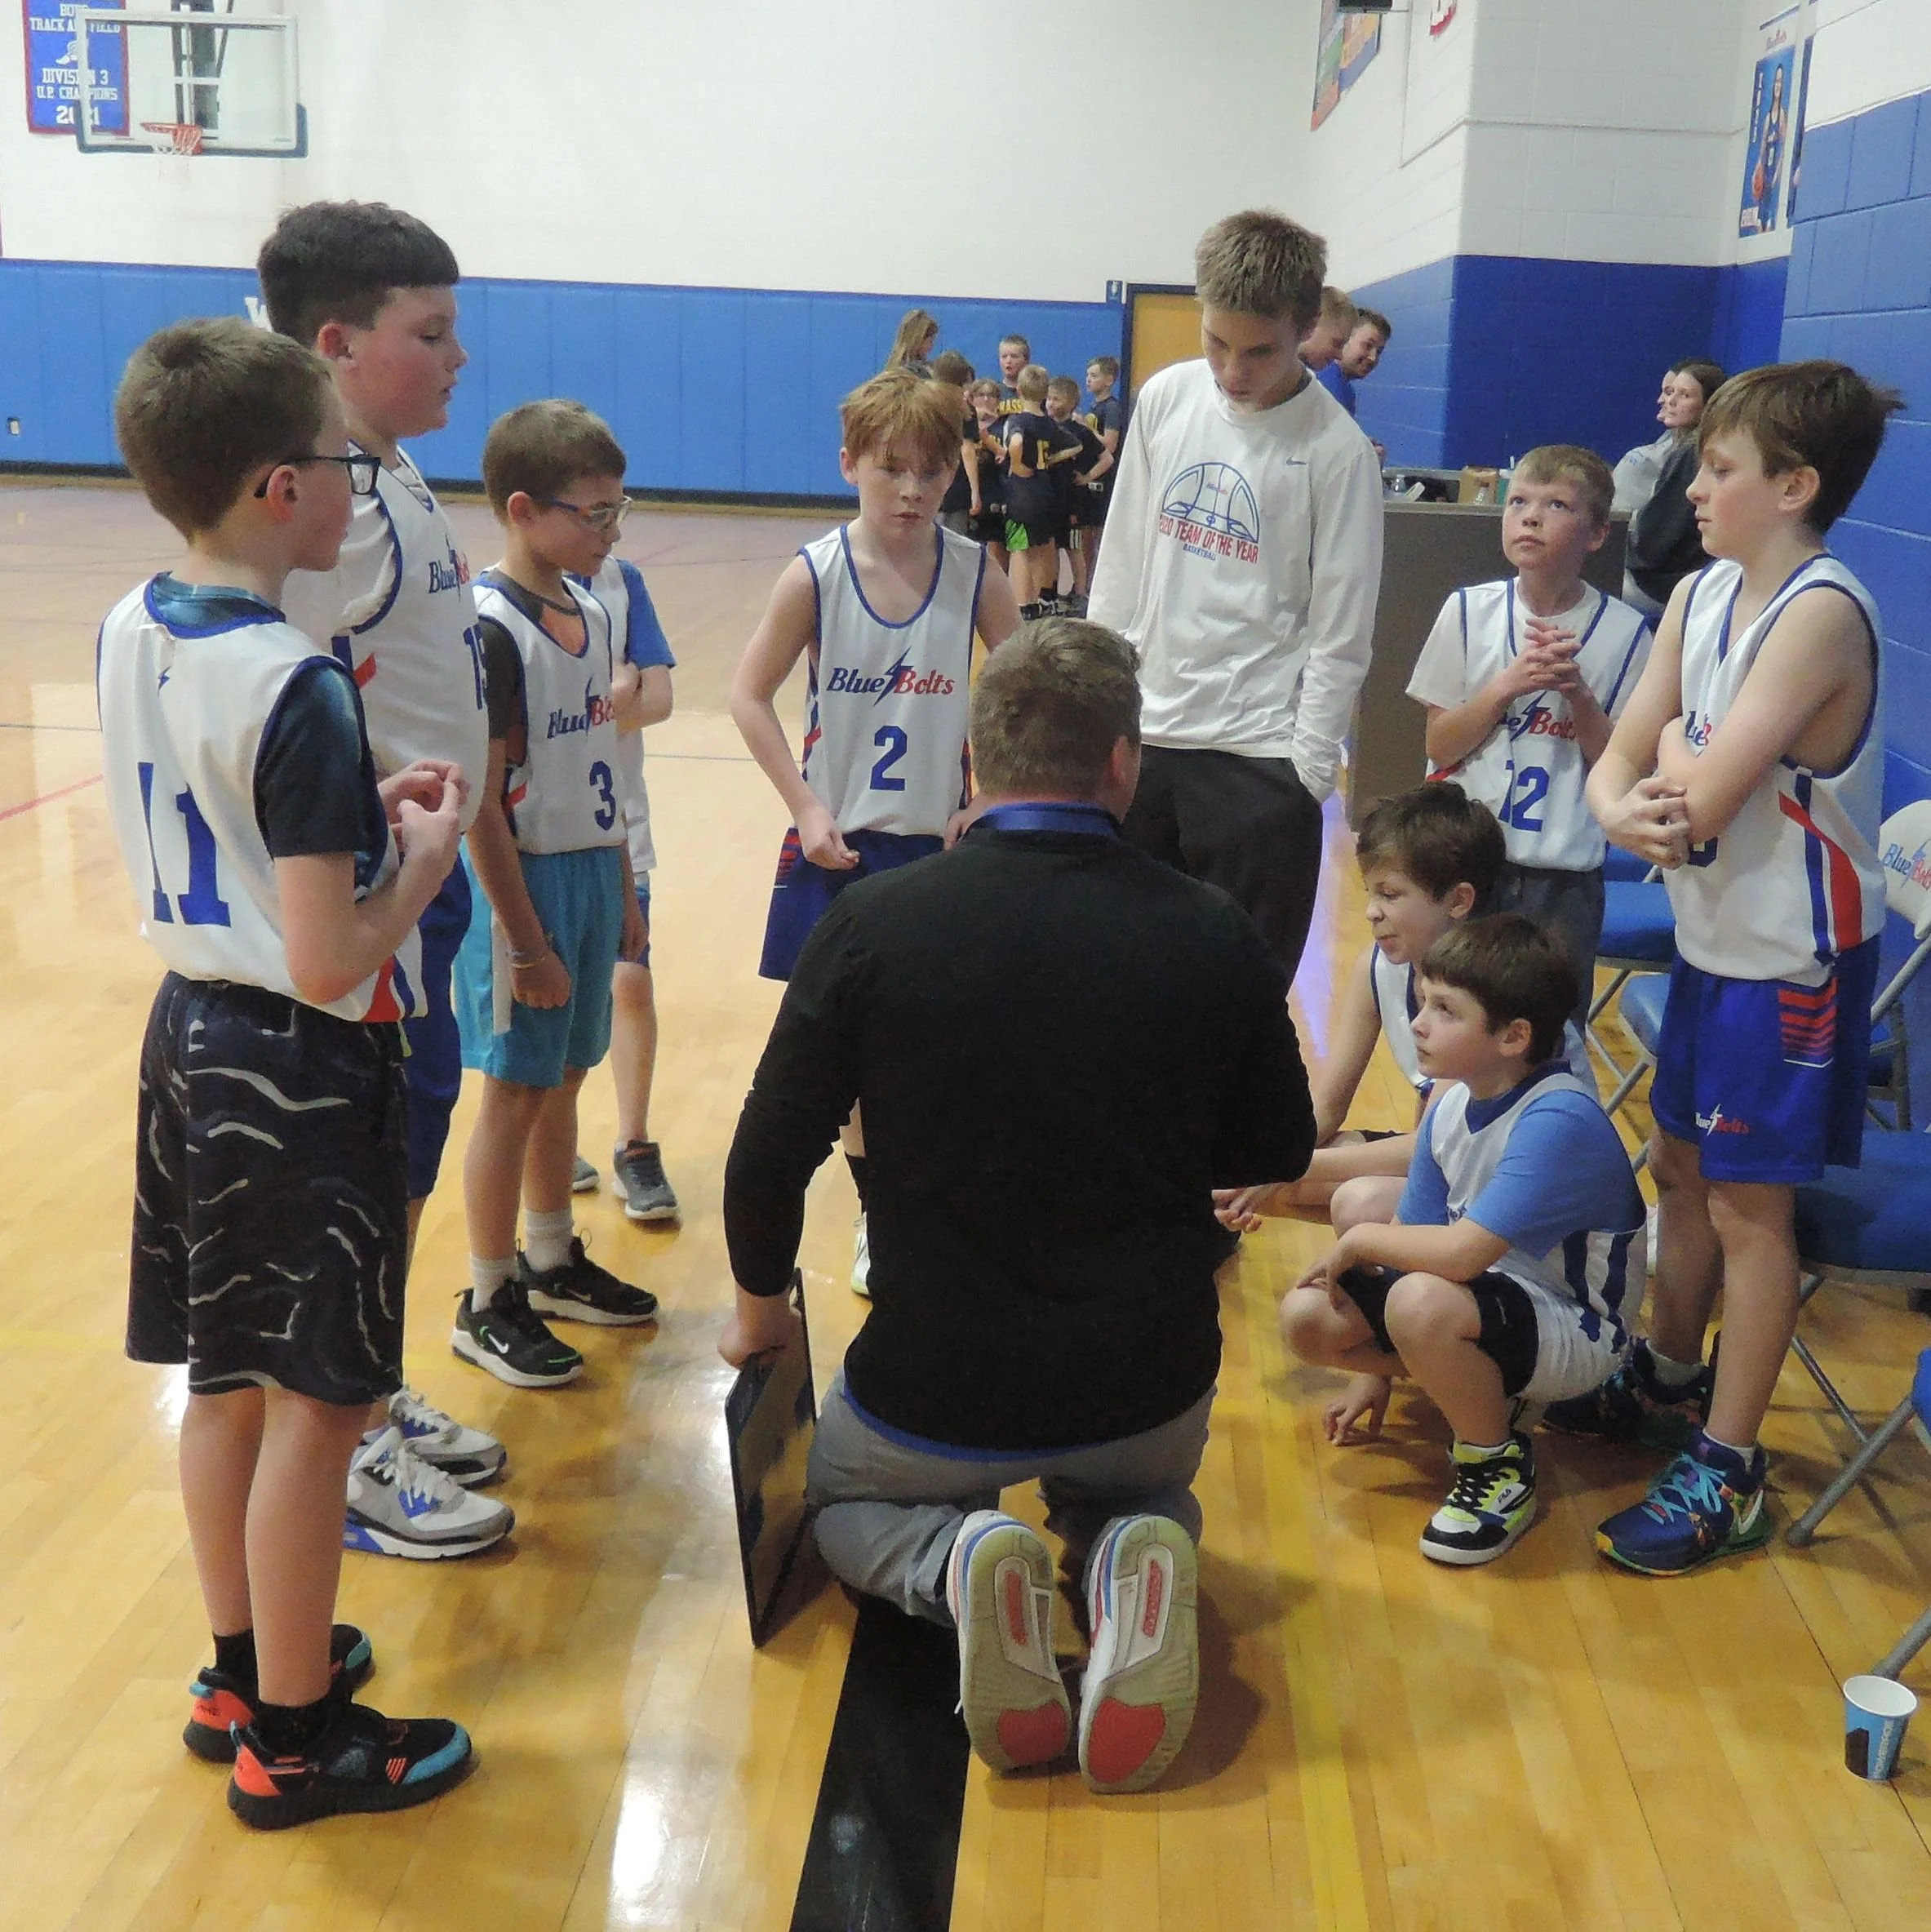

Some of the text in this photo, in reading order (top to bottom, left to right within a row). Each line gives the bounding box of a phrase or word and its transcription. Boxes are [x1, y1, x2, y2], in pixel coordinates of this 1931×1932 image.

[30, 17, 64, 31] TRACK
[100, 69, 109, 85] 3
[59, 87, 118, 100] CHAPIONS
[1174, 520, 1203, 546] TEAM
[1202, 530, 1219, 550] OF
[1215, 533, 1233, 557] THE
[1236, 540, 1259, 565] YEAR
[1183, 543, 1217, 561] BASKETBALL
[428, 560, 455, 594] Blue
[826, 667, 956, 694] Blue Bolts
[869, 725, 908, 791] 2
[589, 761, 616, 831] 3
[1883, 842, 1911, 876] Blue
